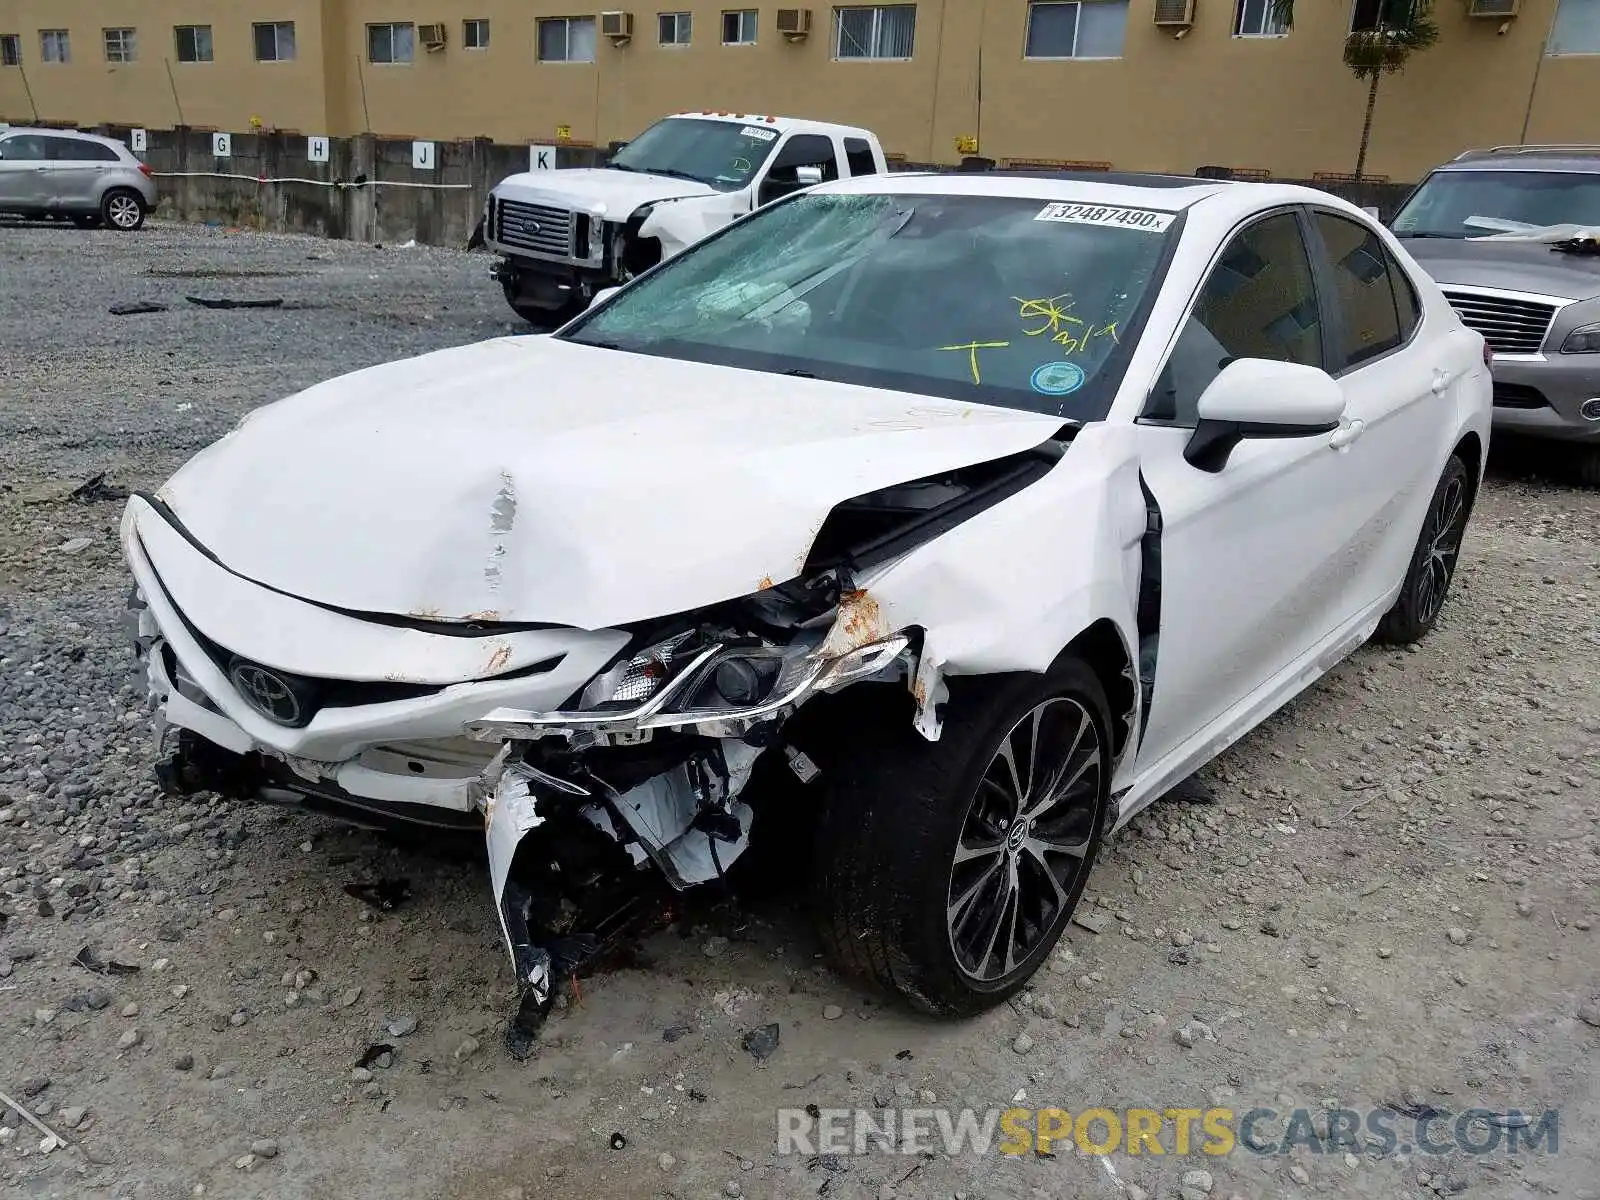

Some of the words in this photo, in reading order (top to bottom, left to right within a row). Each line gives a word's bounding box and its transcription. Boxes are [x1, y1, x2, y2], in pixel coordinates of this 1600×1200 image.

[136, 133, 142, 147] F
[217, 137, 226, 152] G
[314, 141, 323, 157] H
[419, 147, 427, 164] J
[538, 152, 548, 169] K
